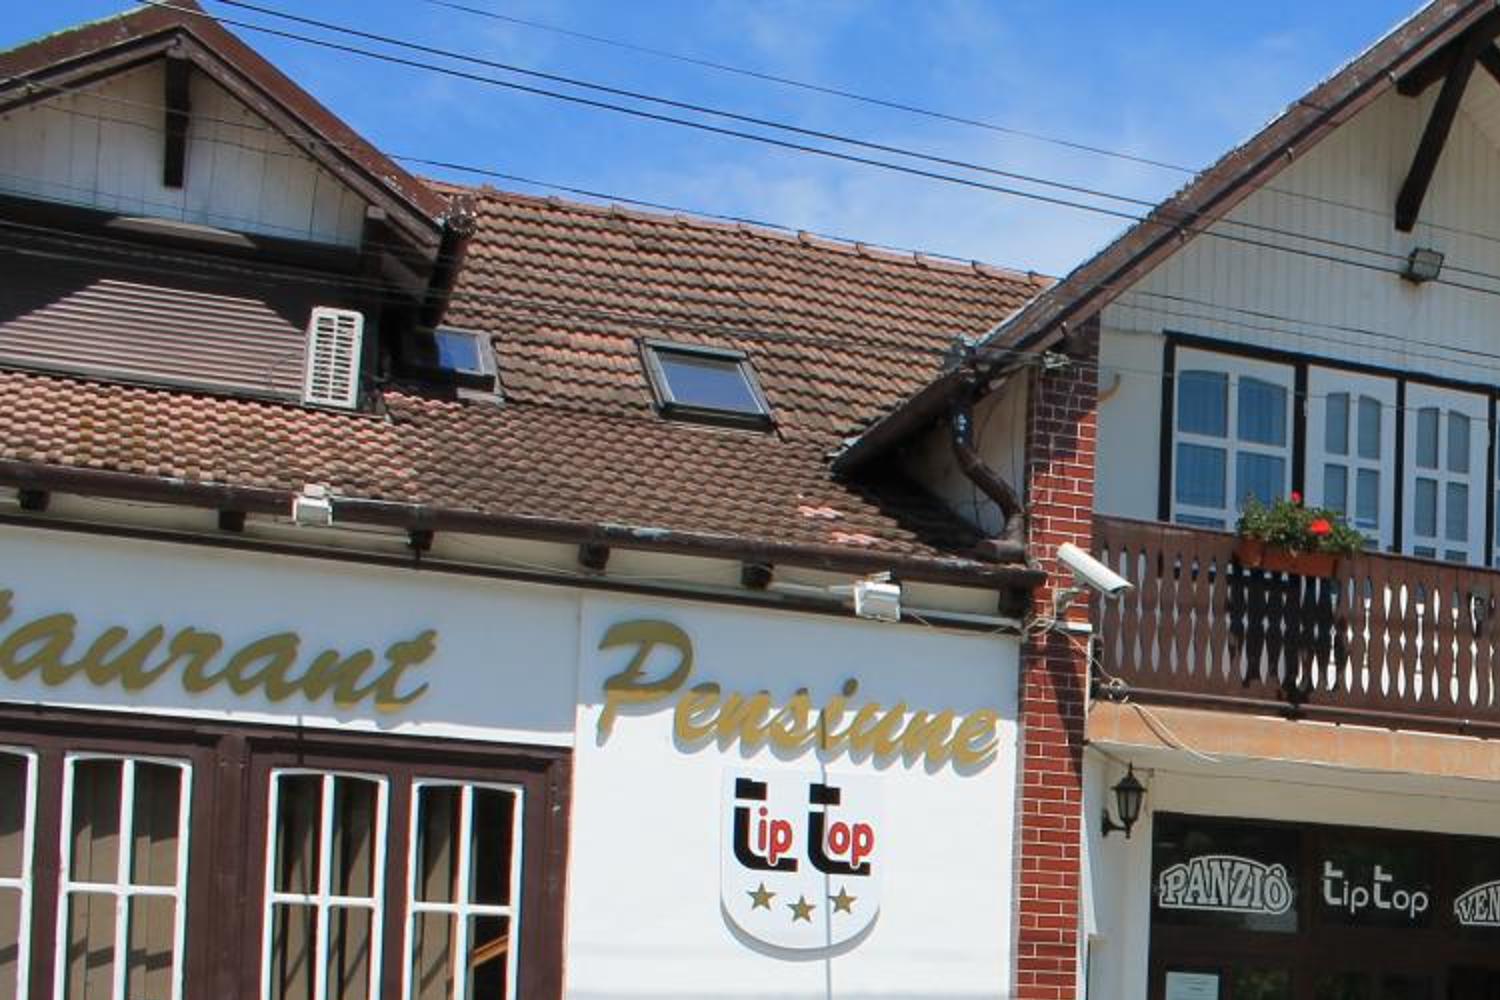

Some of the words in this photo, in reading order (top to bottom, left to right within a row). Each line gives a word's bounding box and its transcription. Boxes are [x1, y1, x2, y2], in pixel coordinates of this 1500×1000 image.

[0, 588, 438, 713] aurant
[598, 618, 1000, 767] Pensiune
[1161, 858, 1292, 912] PANZIÓ
